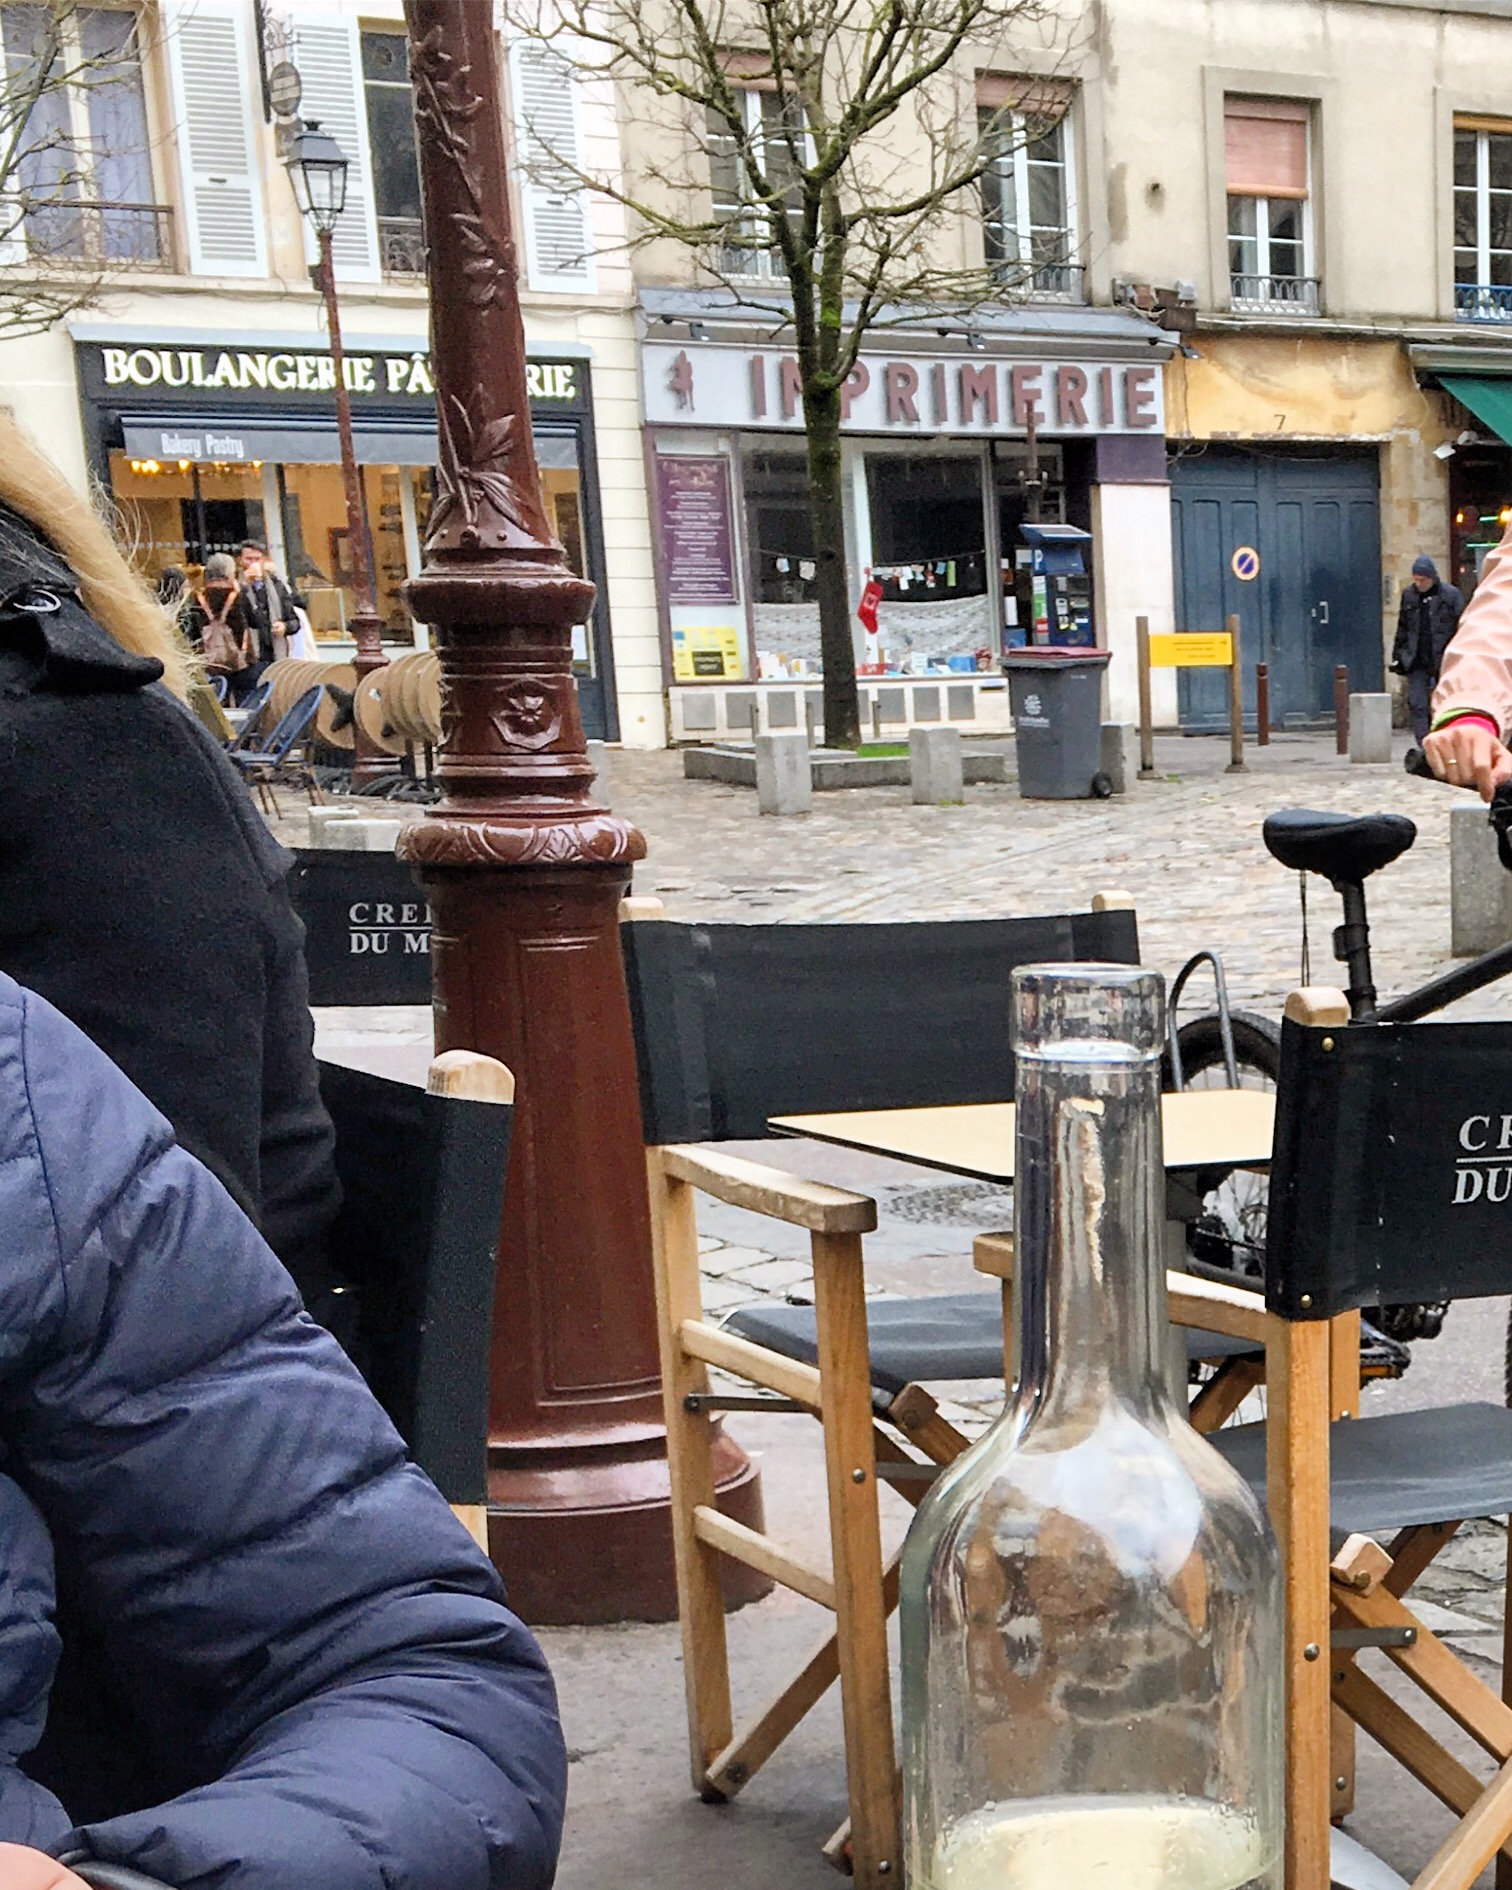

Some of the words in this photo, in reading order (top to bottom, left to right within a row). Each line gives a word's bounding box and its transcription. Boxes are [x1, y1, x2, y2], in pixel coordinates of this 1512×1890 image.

[102, 349, 375, 391] BOULANGERIE
[385, 352, 576, 398] PÂRIE
[1273, 414, 1286, 430] 7
[161, 433, 200, 457] Bakery
[205, 434, 244, 458] Pastry
[350, 932, 390, 954] DU
